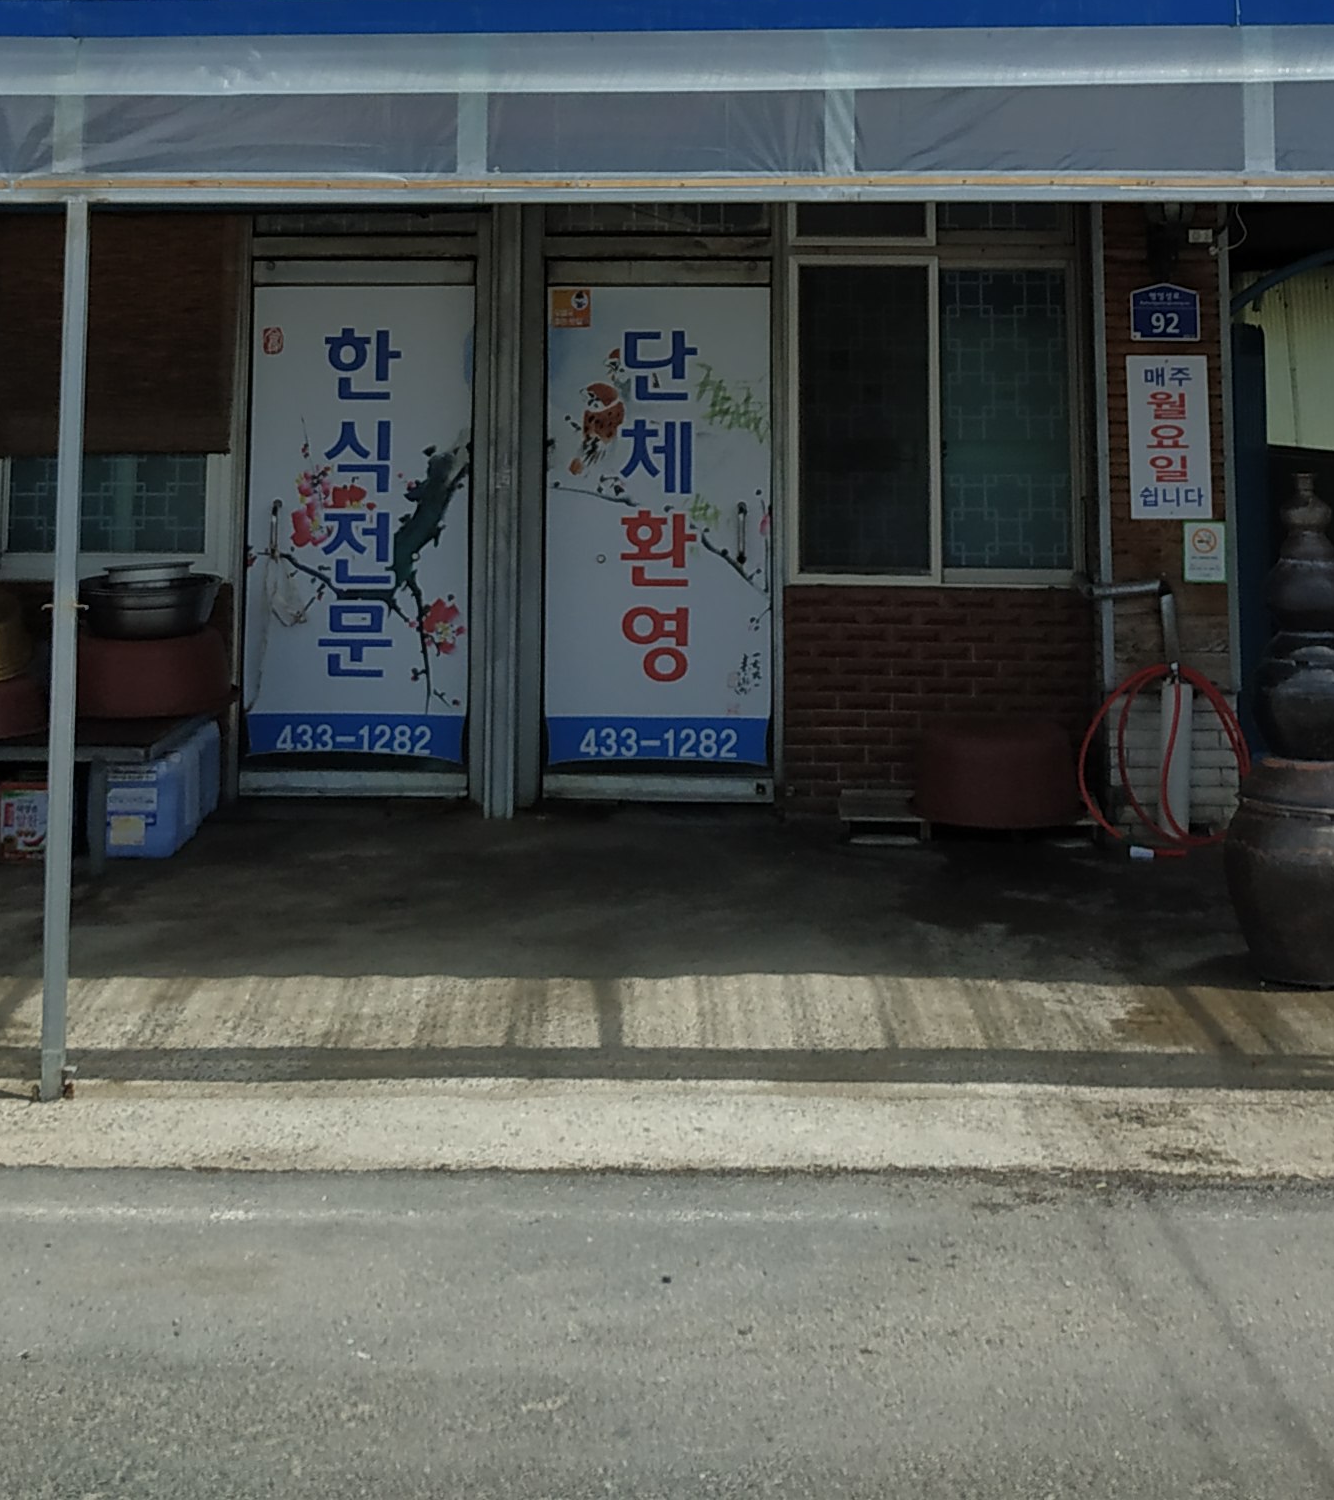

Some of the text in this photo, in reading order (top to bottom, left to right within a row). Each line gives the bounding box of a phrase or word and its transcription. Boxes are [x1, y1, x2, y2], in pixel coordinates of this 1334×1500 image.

[1150, 312, 1180, 334] 92
[1144, 367, 1193, 387] 매주
[1147, 391, 1189, 483] 월요일
[318, 327, 402, 678] 한식전문
[1139, 486, 1204, 508] 쉽니다
[275, 725, 433, 757] 433-1282
[579, 728, 738, 759] 433-1282
